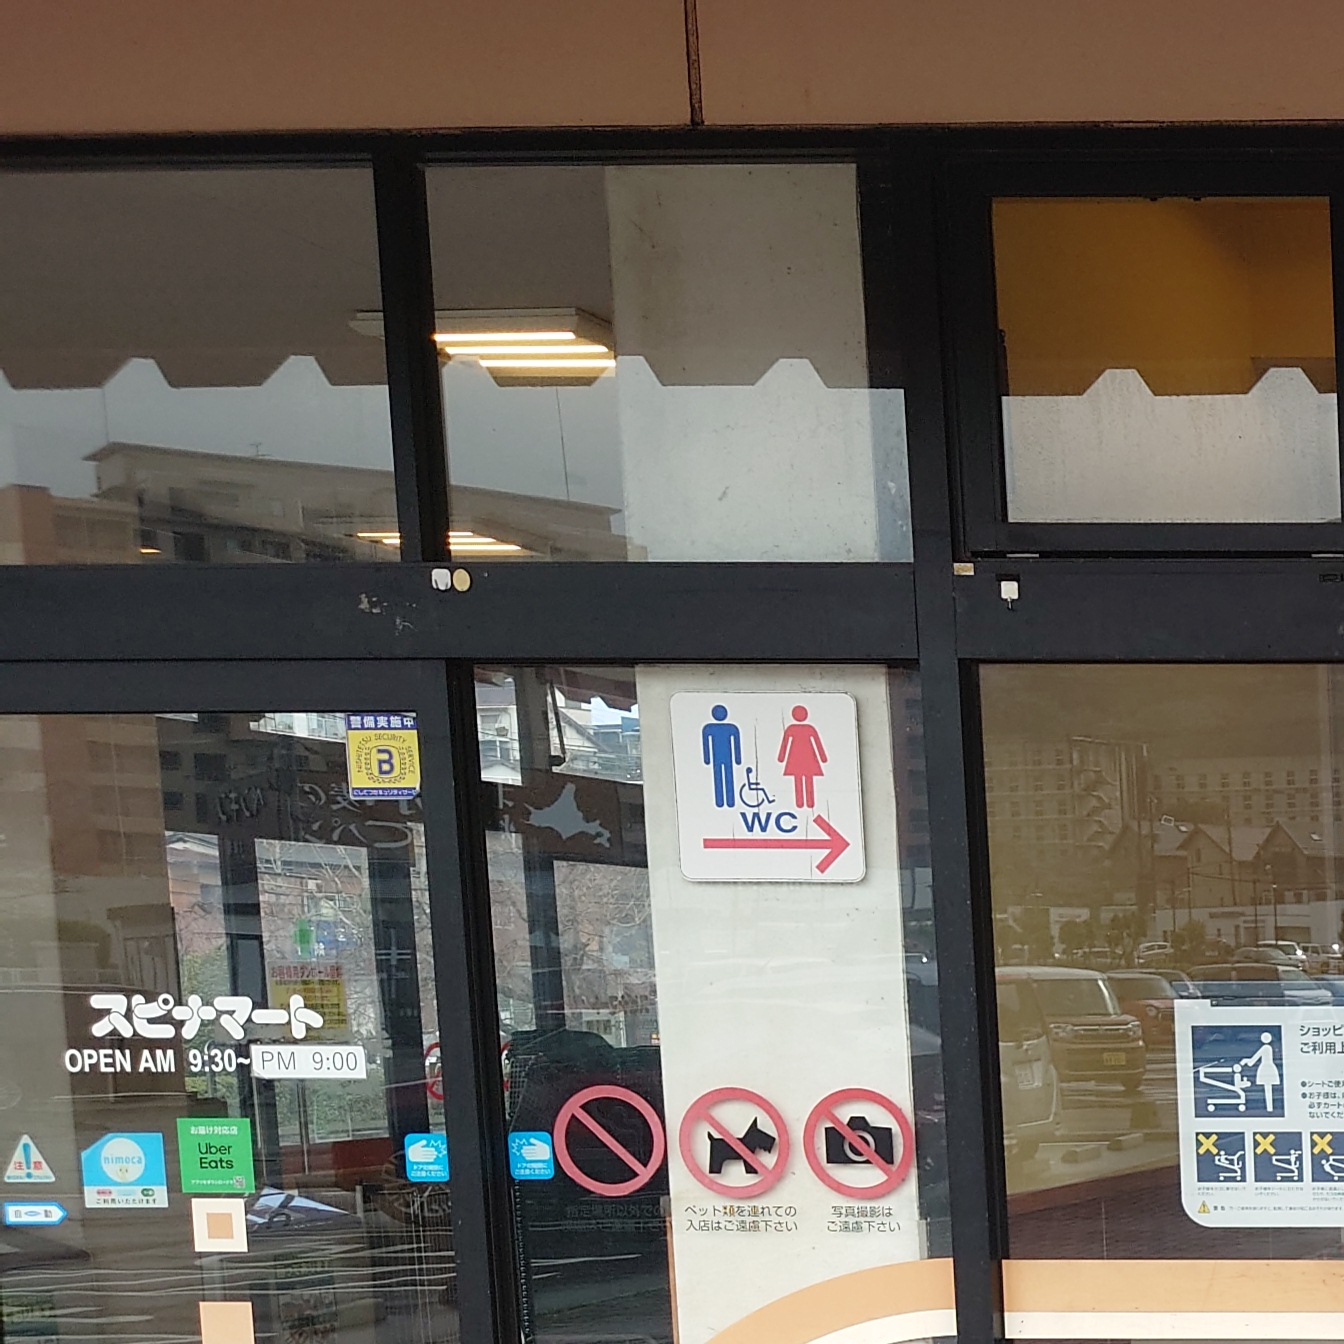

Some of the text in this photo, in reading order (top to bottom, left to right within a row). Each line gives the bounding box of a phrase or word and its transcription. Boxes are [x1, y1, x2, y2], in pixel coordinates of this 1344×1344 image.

[350, 715, 414, 728] 警備実施中
[374, 732, 408, 744] SECURITY
[739, 811, 799, 834] WC
[89, 992, 325, 1040] スピナマート
[64, 1048, 132, 1073] OPEN
[138, 1049, 176, 1073] AM
[260, 1051, 297, 1071] PM
[312, 1050, 359, 1072] 9:00
[197, 1142, 233, 1155] Uber
[103, 1154, 143, 1165] nimoca
[199, 1156, 234, 1170] Eats
[684, 1204, 797, 1218] ペット類を連れての
[831, 1205, 893, 1218] 写真撮影は
[685, 1219, 798, 1233] 入店はご遠慮下さい
[827, 1220, 901, 1233] ご遠慮下さい
